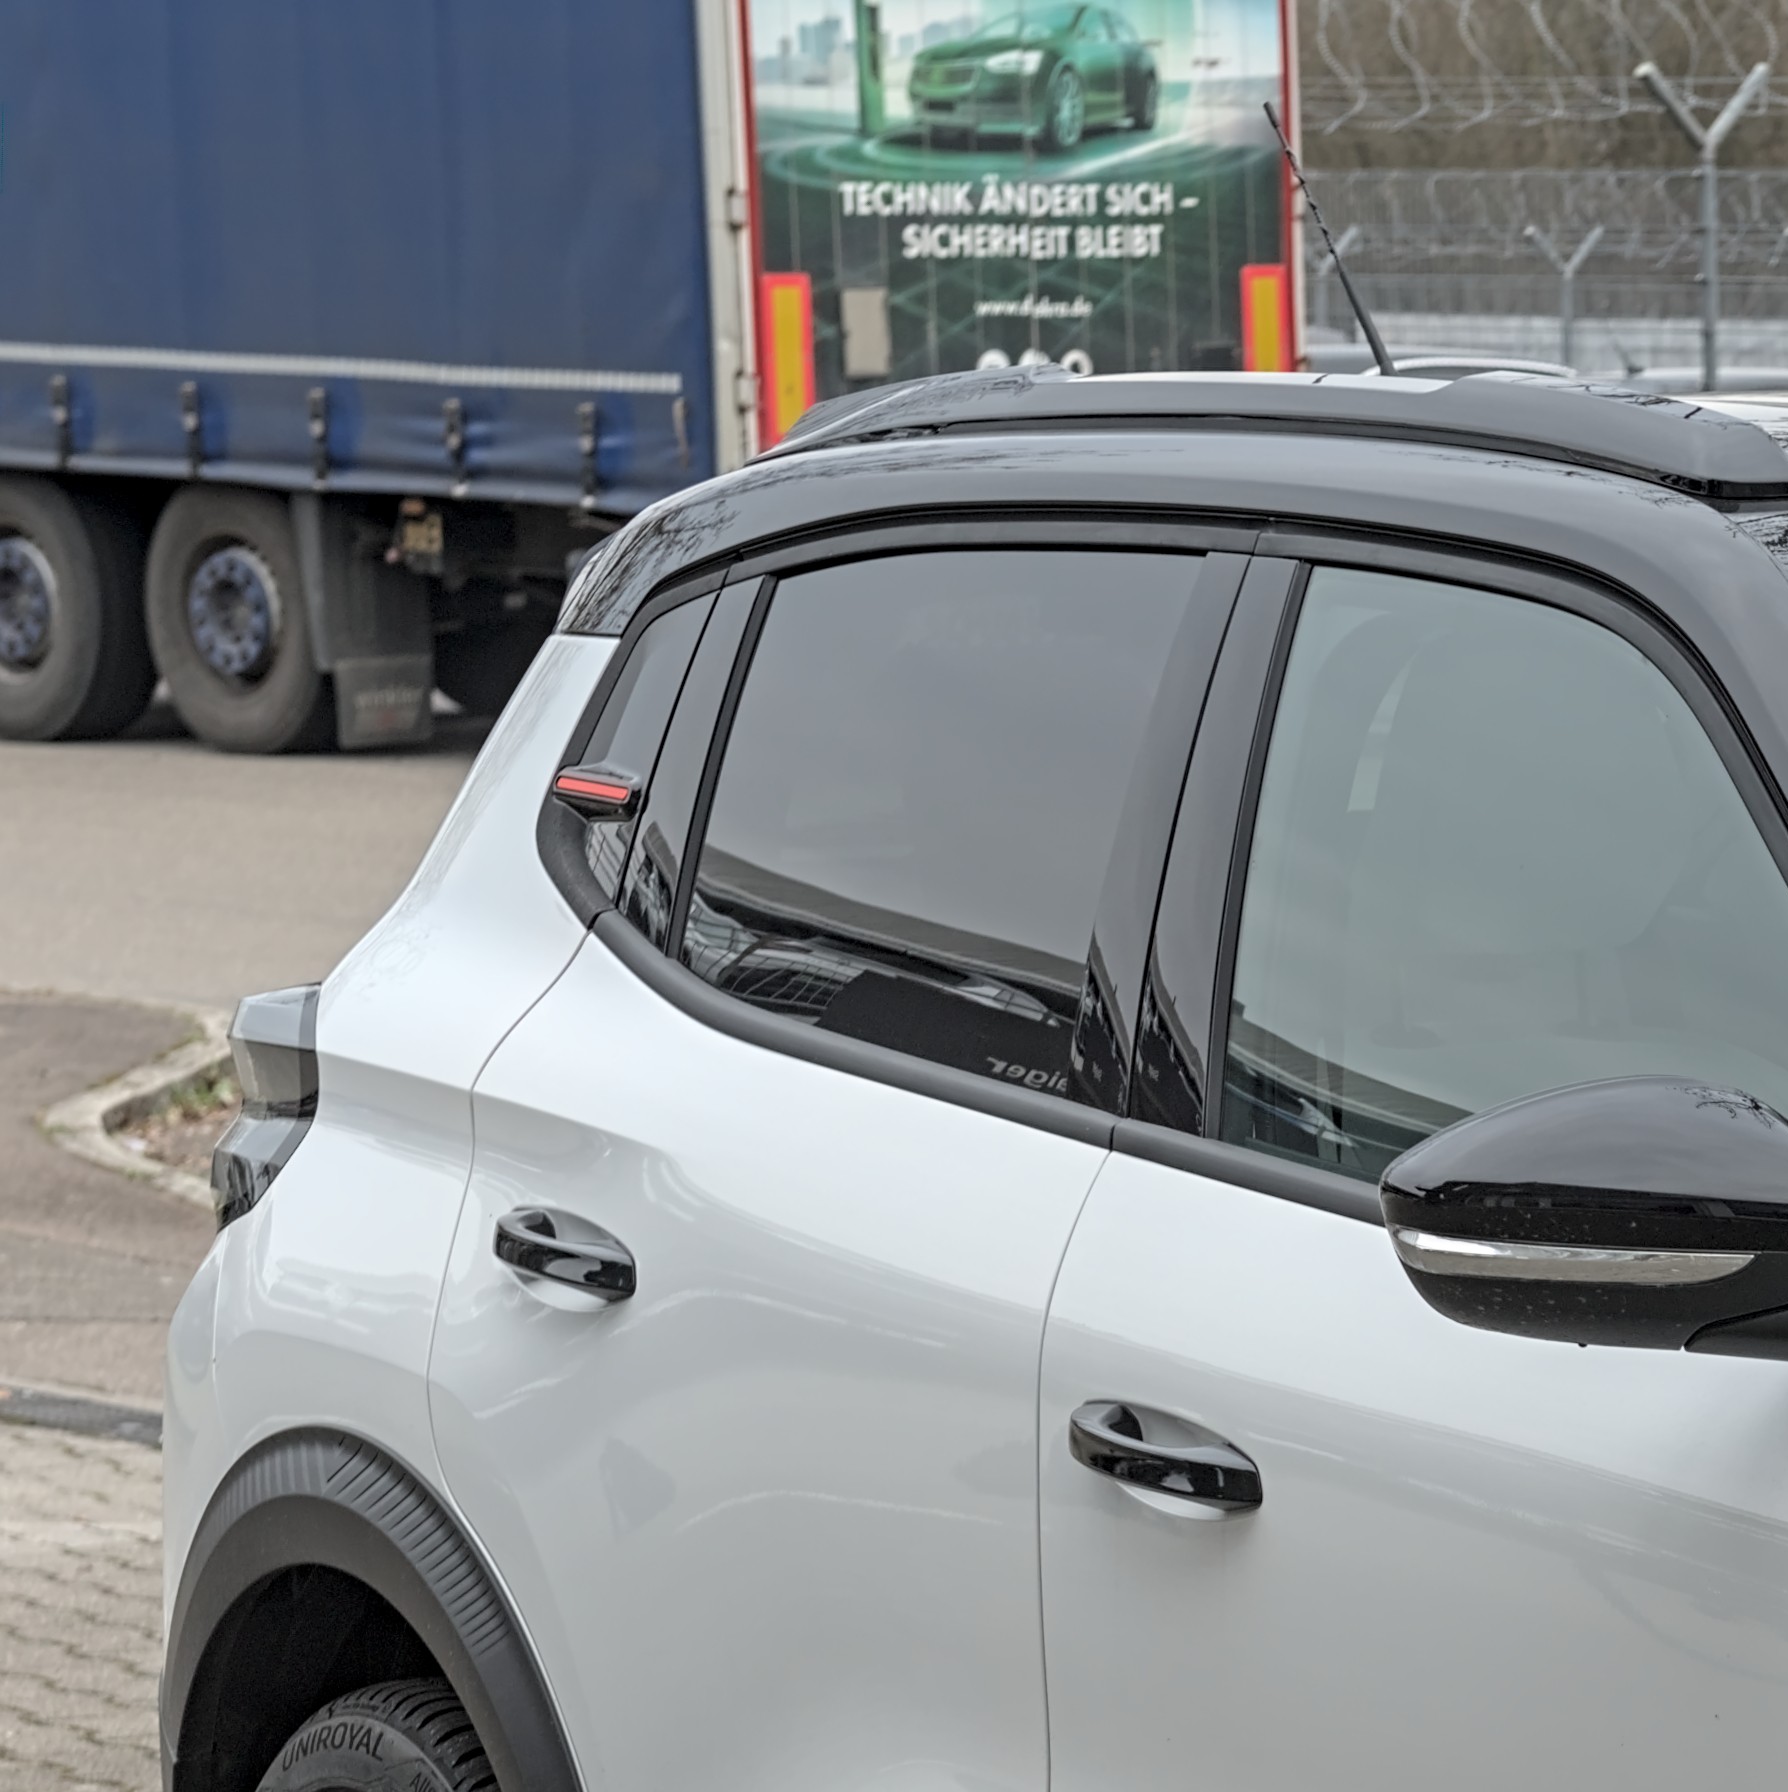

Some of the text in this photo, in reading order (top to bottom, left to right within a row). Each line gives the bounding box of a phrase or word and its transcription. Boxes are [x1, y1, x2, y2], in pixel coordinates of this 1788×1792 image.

[838, 181, 974, 216] TECHNIK
[979, 174, 1101, 218] ÄNDERT
[1104, 182, 1174, 216] SICH
[902, 223, 1165, 259] SICHERHEIT BLEIBT
[281, 1722, 384, 1772] UNIROYAL
